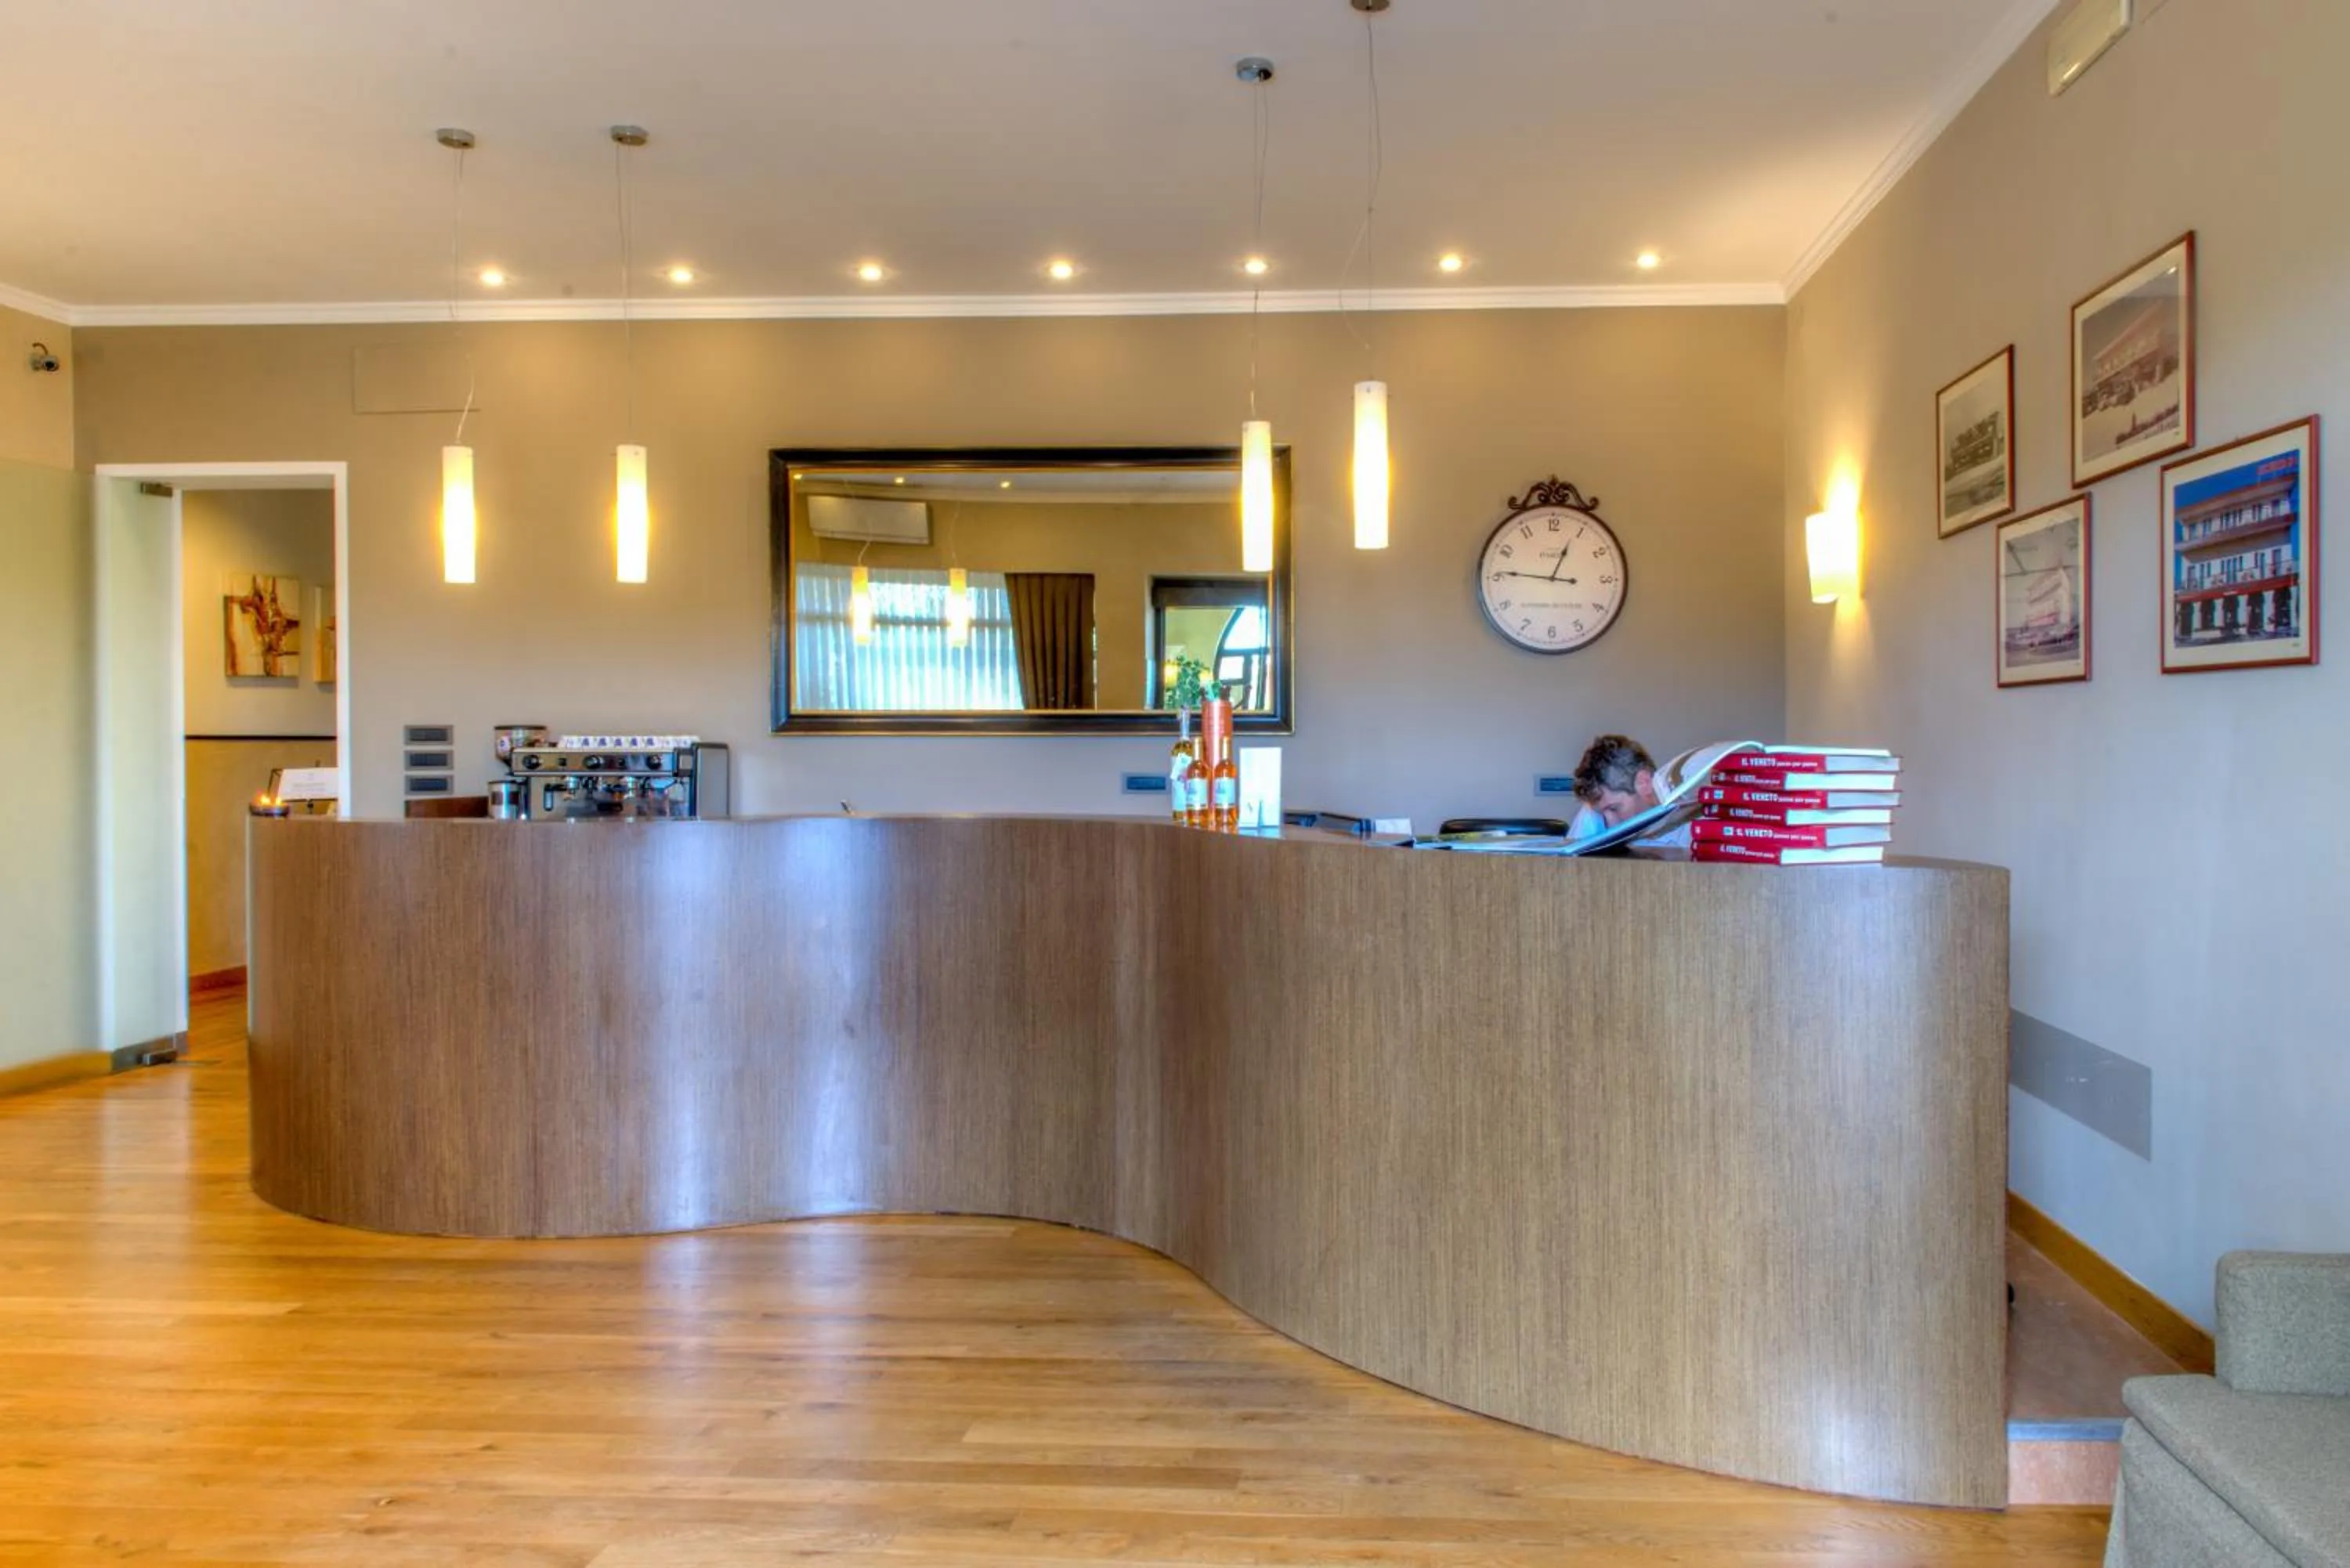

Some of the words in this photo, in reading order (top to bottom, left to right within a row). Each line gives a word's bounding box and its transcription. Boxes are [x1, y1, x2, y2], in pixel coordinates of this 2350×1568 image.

[1548, 518, 1560, 532] 12
[1520, 526, 1533, 540] 11
[1576, 527, 1585, 538] 1
[1499, 544, 1513, 559] 10
[1593, 547, 1605, 558] 2
[1492, 572, 1505, 583] 9
[1599, 575, 1612, 584] 3
[1499, 599, 1511, 611] 8
[1592, 602, 1604, 613] 4
[1520, 619, 1531, 631] 7
[1573, 619, 1584, 632] 5
[1547, 627, 1556, 638] 6
[1750, 758, 1776, 767] VENETO
[1752, 793, 1778, 802] VENETO
[1744, 829, 1773, 837] VENETO
